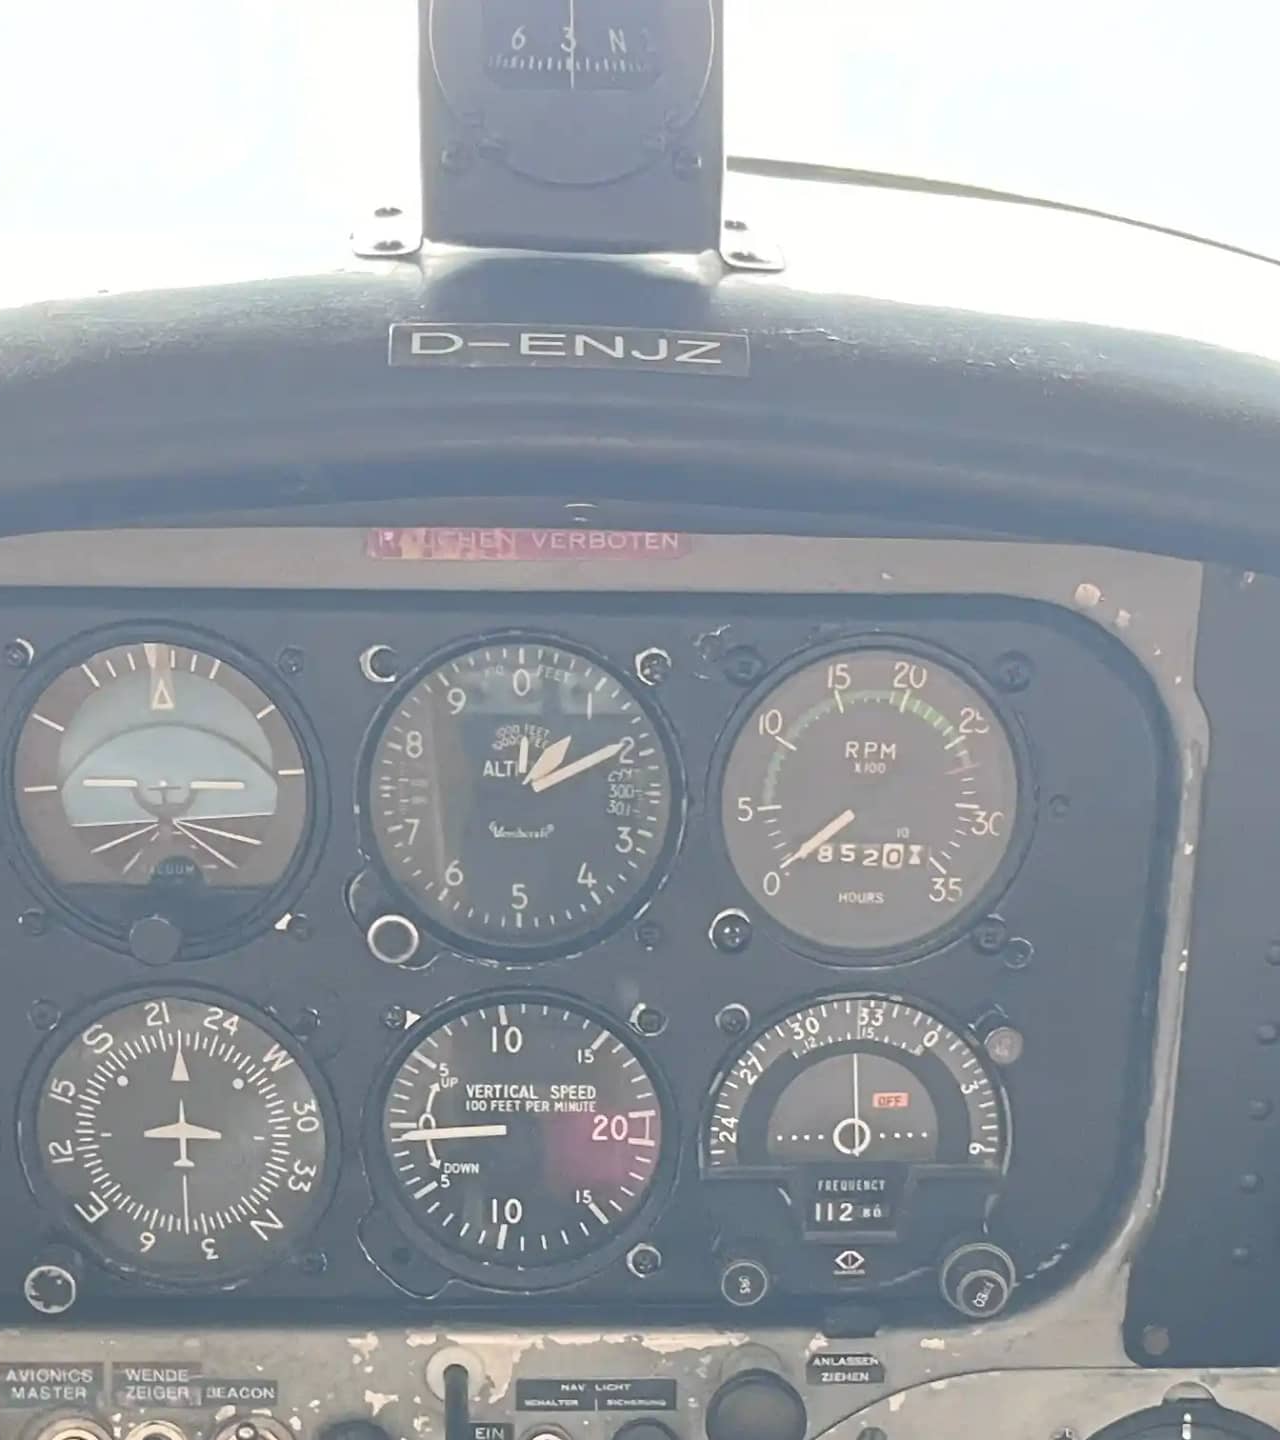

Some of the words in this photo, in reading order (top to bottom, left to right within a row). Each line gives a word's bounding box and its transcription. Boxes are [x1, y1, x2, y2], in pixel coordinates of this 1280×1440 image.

[511, 27, 526, 51] 6
[410, 332, 723, 364] D-ENJZ
[531, 532, 680, 550] VERBOTEN
[512, 668, 531, 696] 0
[827, 665, 851, 689] 15
[893, 662, 927, 689] 20
[447, 687, 466, 714] 9
[758, 709, 783, 736] 10
[958, 706, 990, 735] 25
[405, 730, 423, 758] 8
[619, 736, 635, 765] 2
[845, 741, 896, 760] RPM
[737, 797, 753, 822] 5
[404, 818, 421, 845] 7
[971, 811, 1004, 837] 30
[615, 825, 634, 853] 3
[444, 860, 464, 886] 6
[577, 862, 596, 888] 4
[763, 871, 780, 896] 0
[510, 883, 528, 910] 5
[838, 891, 884, 905] HOURS
[928, 877, 963, 903] 35
[144, 1001, 170, 1027] 21
[203, 1007, 240, 1036] 24
[858, 1008, 884, 1026] 33
[82, 1024, 114, 1054] S
[491, 1026, 523, 1053] 10
[791, 1016, 821, 1040] 30
[923, 1030, 939, 1048] 0
[803, 1037, 818, 1050] 12
[262, 1044, 295, 1073] W
[577, 1049, 594, 1063] 15
[439, 1063, 449, 1077] 5
[739, 1054, 765, 1085] 27
[48, 1078, 75, 1104] 15
[441, 1077, 458, 1088] UP
[466, 1085, 538, 1100] VERTICAL
[550, 1085, 596, 1100] SPEED
[466, 1100, 488, 1112] 100
[490, 1101, 521, 1112] FEET
[526, 1101, 549, 1112] PER
[554, 1101, 596, 1113] MINUTE
[878, 1095, 902, 1106] OFF
[293, 1099, 319, 1133] 30
[591, 1114, 628, 1141] 20
[719, 1117, 739, 1143] 24
[48, 1140, 75, 1164] 12
[287, 1159, 317, 1193] 33
[443, 1163, 480, 1174] DOWN
[440, 1175, 451, 1188] 5
[74, 1191, 109, 1223] E
[575, 1190, 592, 1204] 15
[491, 1198, 523, 1224] 10
[815, 1203, 853, 1222] 112
[250, 1208, 284, 1241] N
[140, 1231, 156, 1253] 6
[201, 1238, 219, 1260] 3
[812, 1356, 878, 1366] ANLASSEN
[5, 1369, 93, 1382] AVIONICS
[125, 1368, 189, 1382] WENDE
[561, 1382, 586, 1392] NAV
[595, 1382, 631, 1392] LICHT
[821, 1372, 870, 1382] ZIEHEN
[12, 1387, 88, 1400] MASTER
[125, 1386, 190, 1400] ZEIGER
[206, 1388, 275, 1399] BEACON
[475, 1427, 505, 1440] EIN
